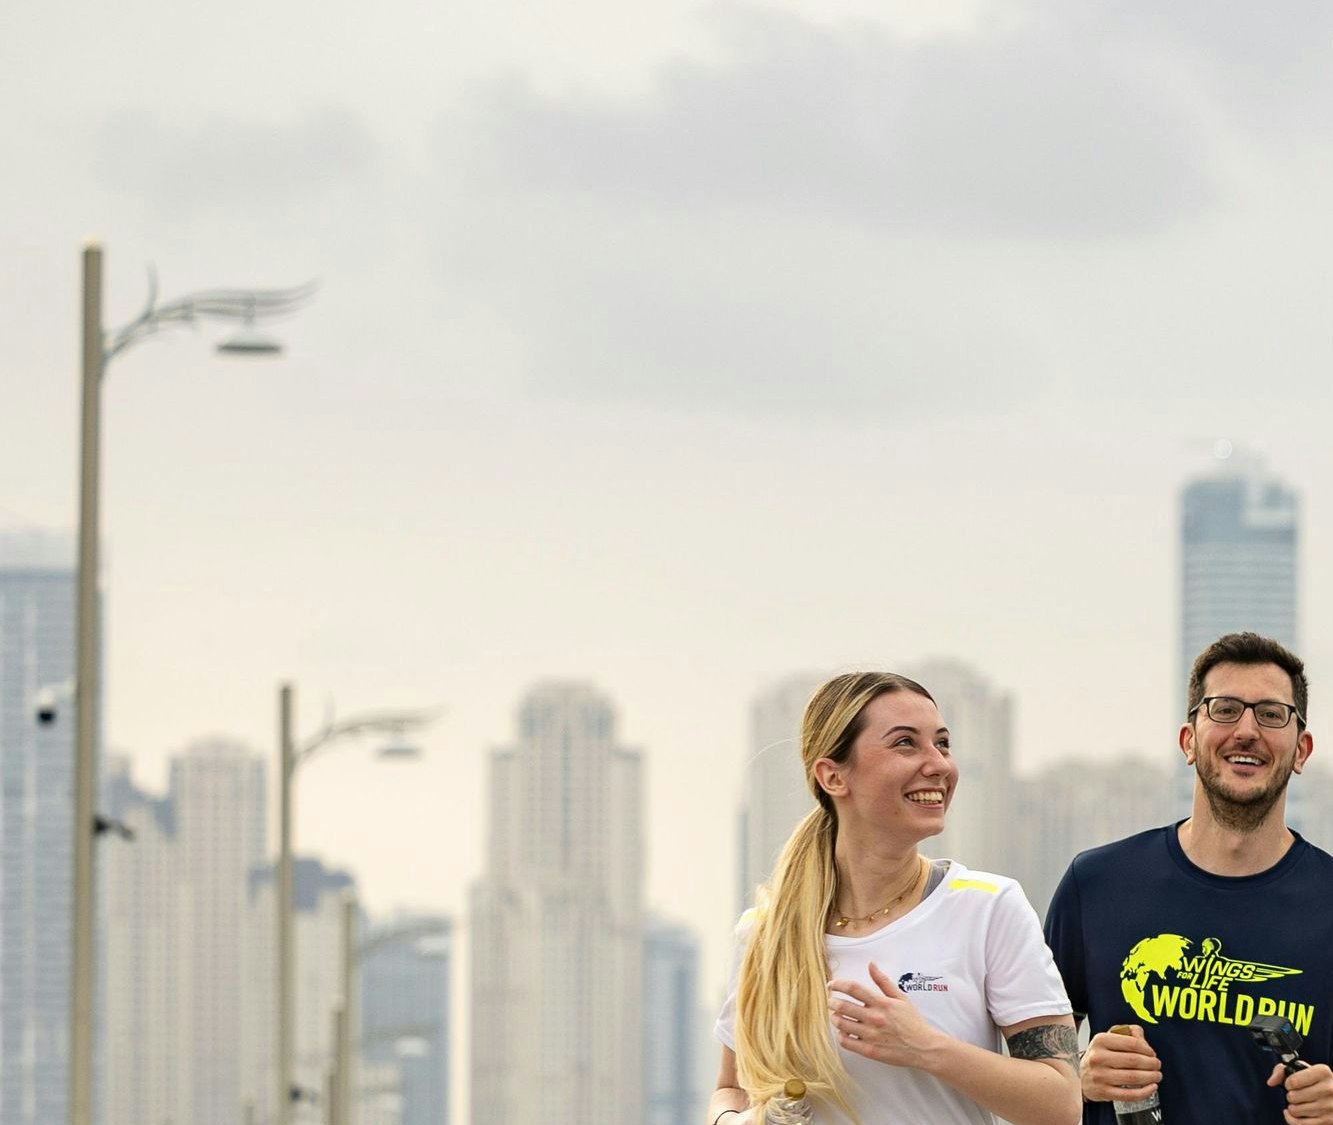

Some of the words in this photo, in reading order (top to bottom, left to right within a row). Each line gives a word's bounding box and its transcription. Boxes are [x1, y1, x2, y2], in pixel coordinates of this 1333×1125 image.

[1183, 955, 1256, 979] WINGS
[905, 983, 932, 992] WORLD
[933, 984, 949, 992] RUN
[1176, 971, 1194, 980] FOR
[1190, 973, 1234, 992] LIFE
[1151, 984, 1255, 1027] WORLD
